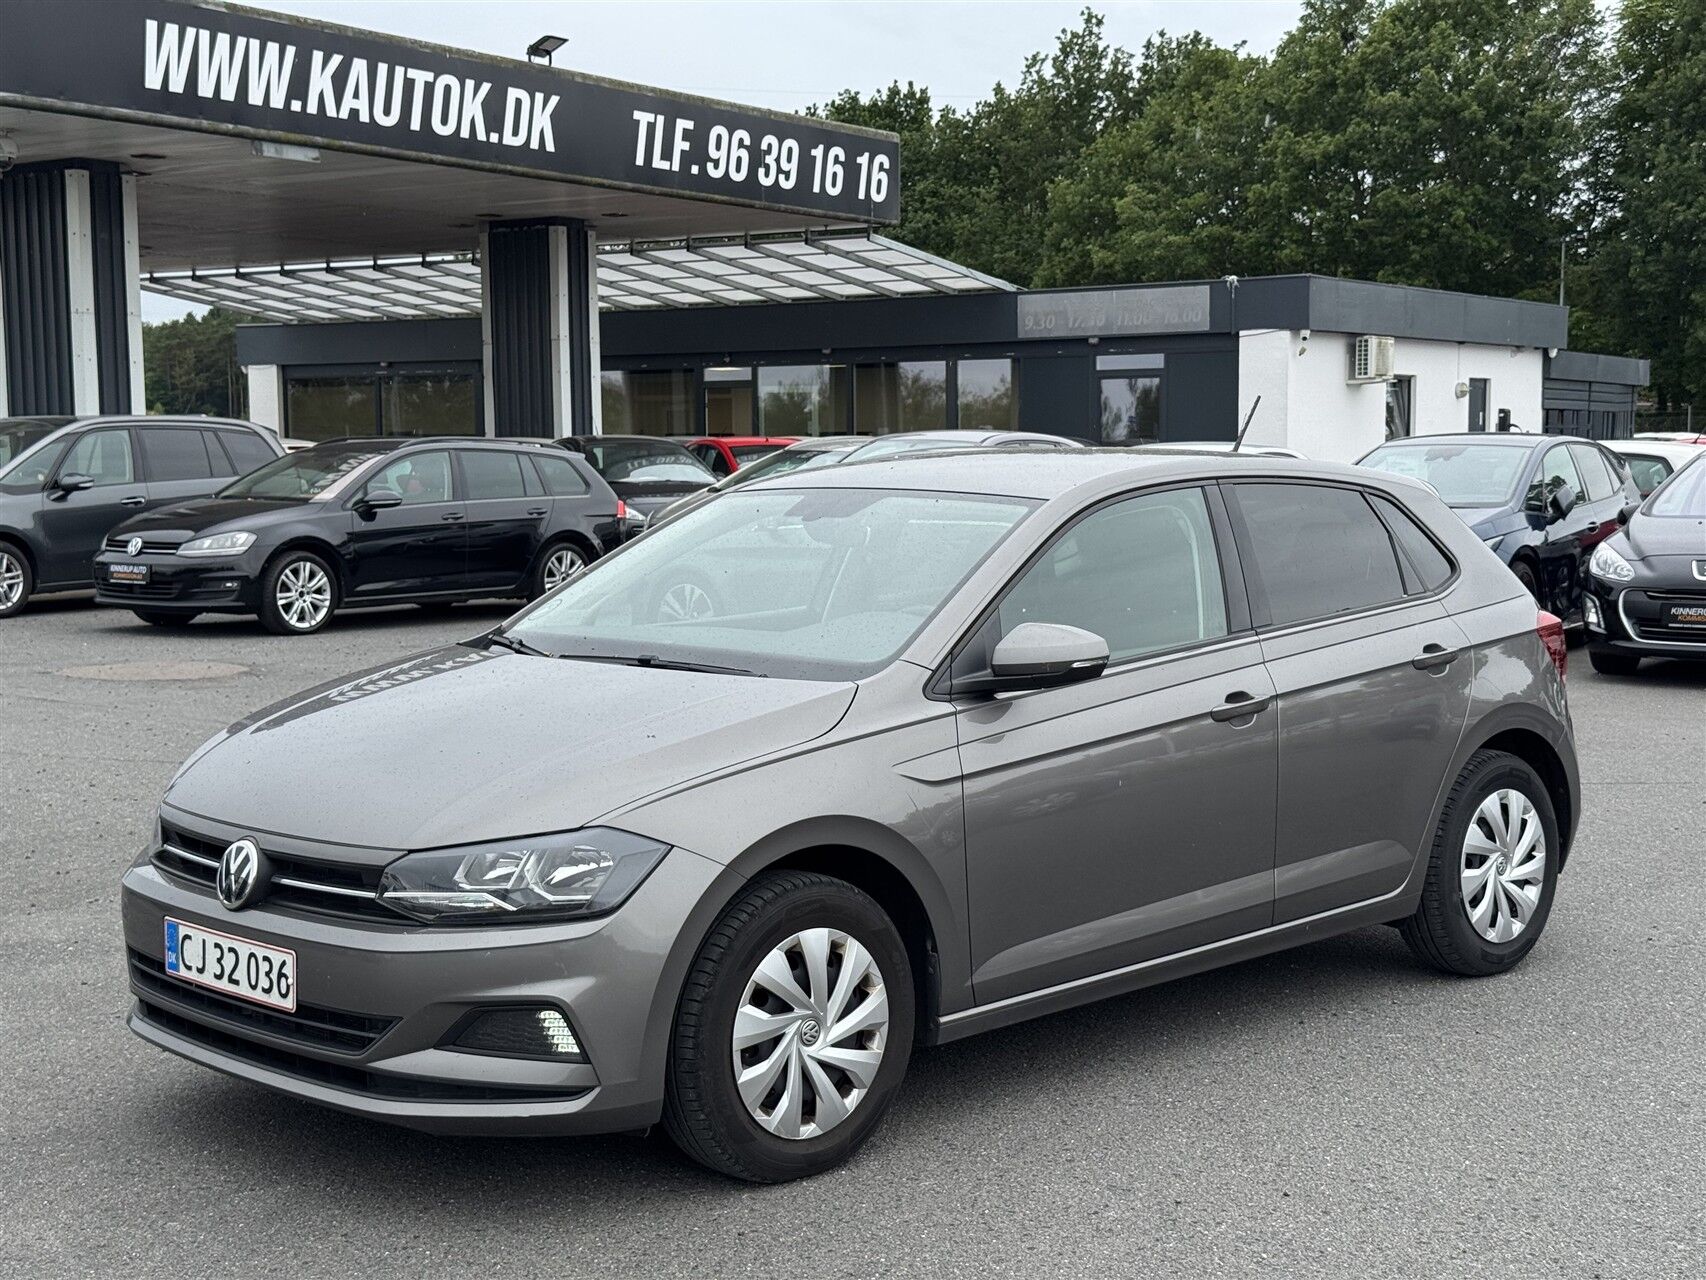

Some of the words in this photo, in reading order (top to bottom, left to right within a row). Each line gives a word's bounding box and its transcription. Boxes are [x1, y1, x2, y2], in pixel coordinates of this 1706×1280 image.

[144, 19, 561, 153] WWW.KAUTOK.DK
[632, 110, 699, 175] TLF.
[706, 125, 751, 182] 96
[757, 134, 800, 190] 39
[810, 144, 846, 197] 16
[856, 152, 890, 203] 16
[1024, 315, 1056, 330] 9.30
[168, 951, 177, 964] DK
[180, 933, 206, 975] CJ
[213, 942, 241, 987] 32
[247, 951, 291, 999] 036
